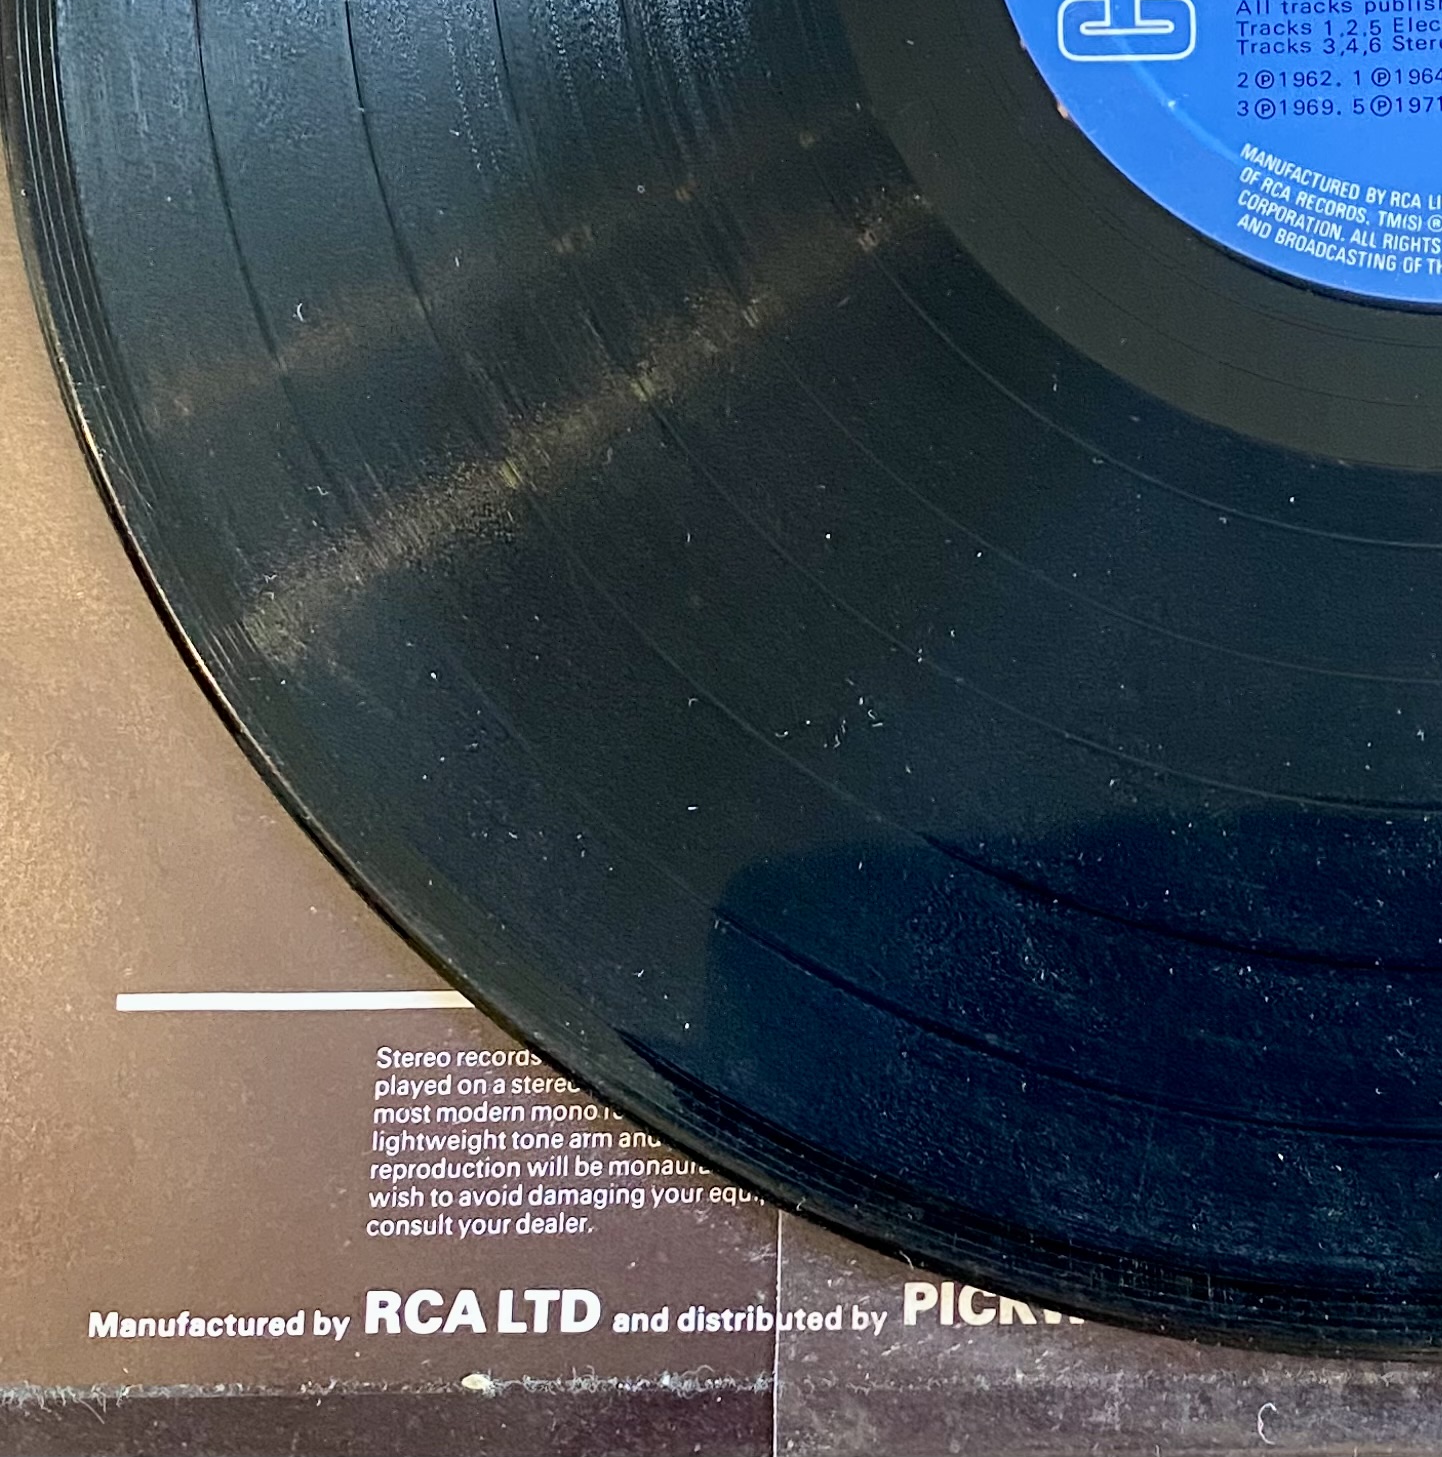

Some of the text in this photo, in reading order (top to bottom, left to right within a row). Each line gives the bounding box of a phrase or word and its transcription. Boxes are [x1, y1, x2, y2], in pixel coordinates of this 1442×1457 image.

[1236, 0, 1270, 15] All
[1237, 20, 1312, 37] Tracks
[1236, 38, 1312, 55] Tracks
[1241, 143, 1360, 200] MANUFACTURED
[1390, 191, 1421, 209] RCA
[1261, 177, 1290, 199] RCA
[1295, 191, 1370, 226] RECORDS.
[1379, 210, 1422, 232] TM(S)
[1238, 190, 1344, 242] CORPORATION.
[1350, 228, 1376, 248] ALL
[1383, 233, 1441, 253] RIGHTS
[1237, 214, 1271, 239] AND
[1274, 228, 1397, 271] BROADCASTING
[376, 1046, 451, 1070] Stereo
[374, 1075, 487, 1100] played on
[373, 1104, 430, 1125] most
[436, 1102, 525, 1123] modern
[530, 1104, 598, 1123] mono
[371, 1130, 612, 1158] lightweight tone arm
[370, 1155, 603, 1185] reproduction will be
[369, 1182, 703, 1212] wish to avoid damaging your
[366, 1210, 595, 1241] consult your dealer.
[88, 1310, 305, 1338] Manufactured
[312, 1310, 351, 1341] by
[365, 1289, 487, 1334] RCA
[497, 1289, 601, 1334] LTD
[612, 1306, 669, 1333] and
[677, 1305, 843, 1333] distributed
[851, 1305, 888, 1335] by
